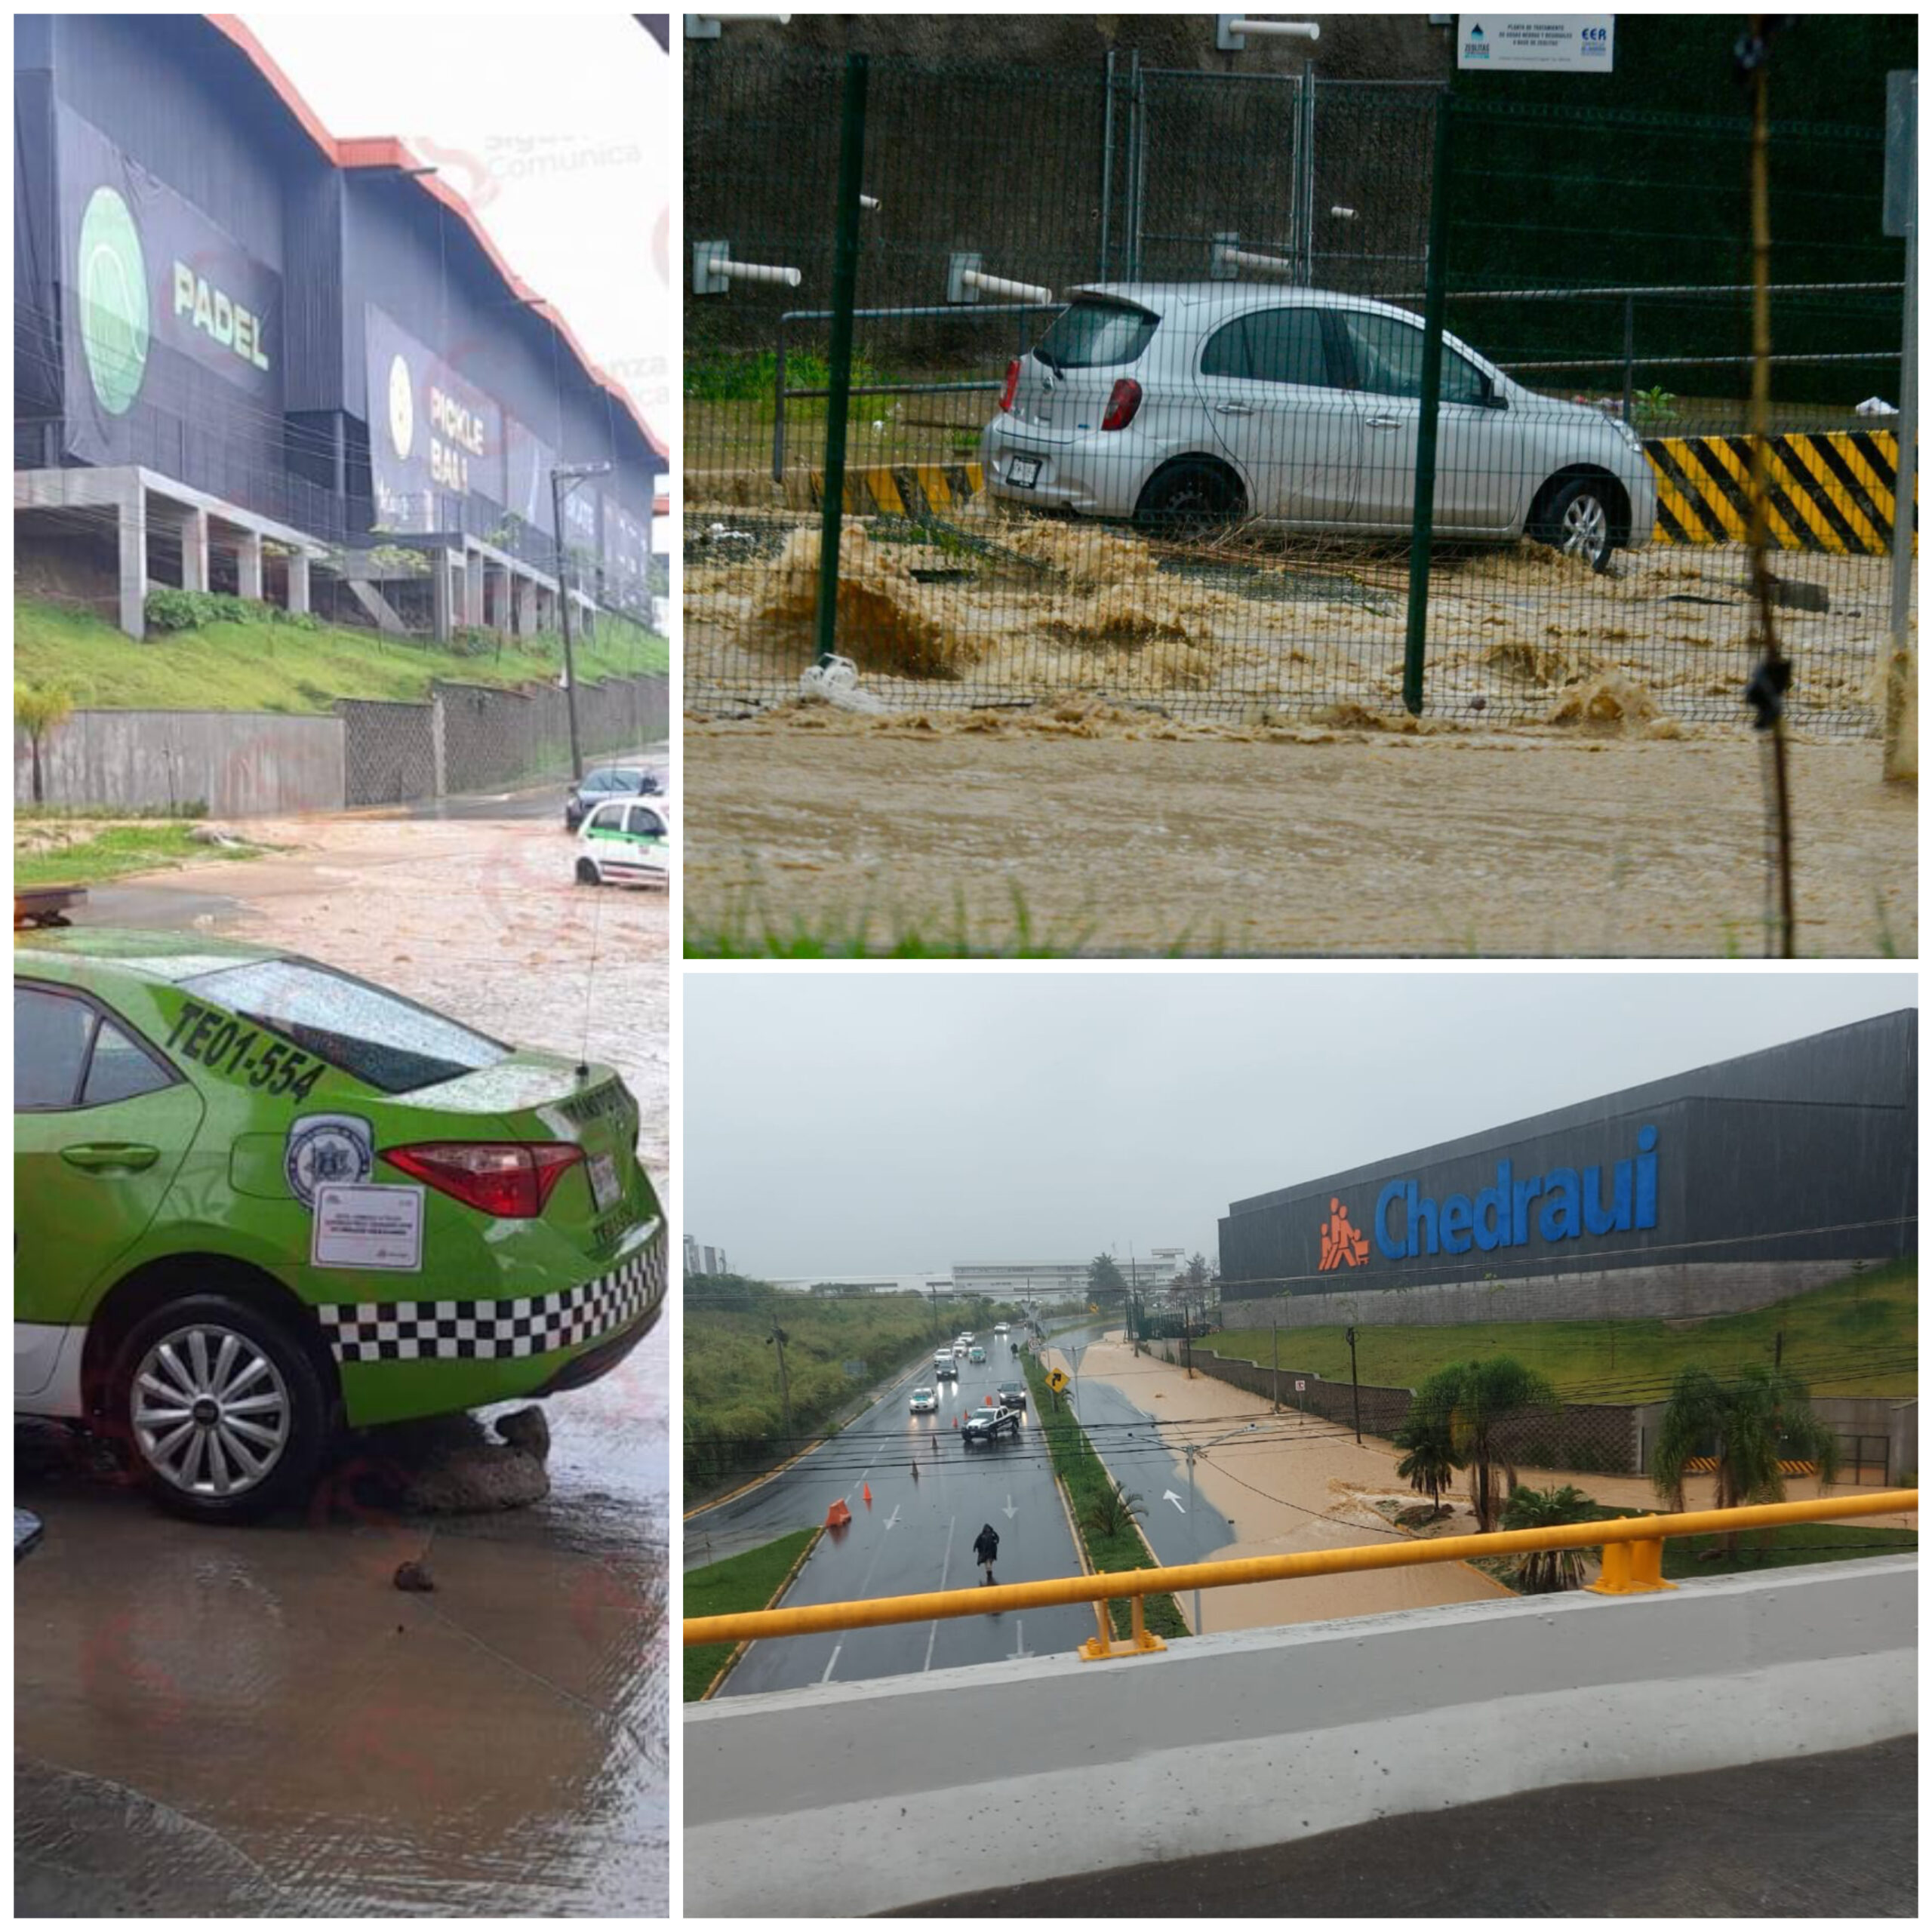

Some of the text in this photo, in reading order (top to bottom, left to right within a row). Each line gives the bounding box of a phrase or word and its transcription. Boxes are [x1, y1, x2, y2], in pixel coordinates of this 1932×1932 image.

[1581, 27, 1607, 41] EER
[174, 259, 269, 372] PADEL
[430, 386, 484, 457] PICKLE
[166, 1001, 327, 1104] TE01-554
[1374, 1124, 1658, 1260] Chedraui
